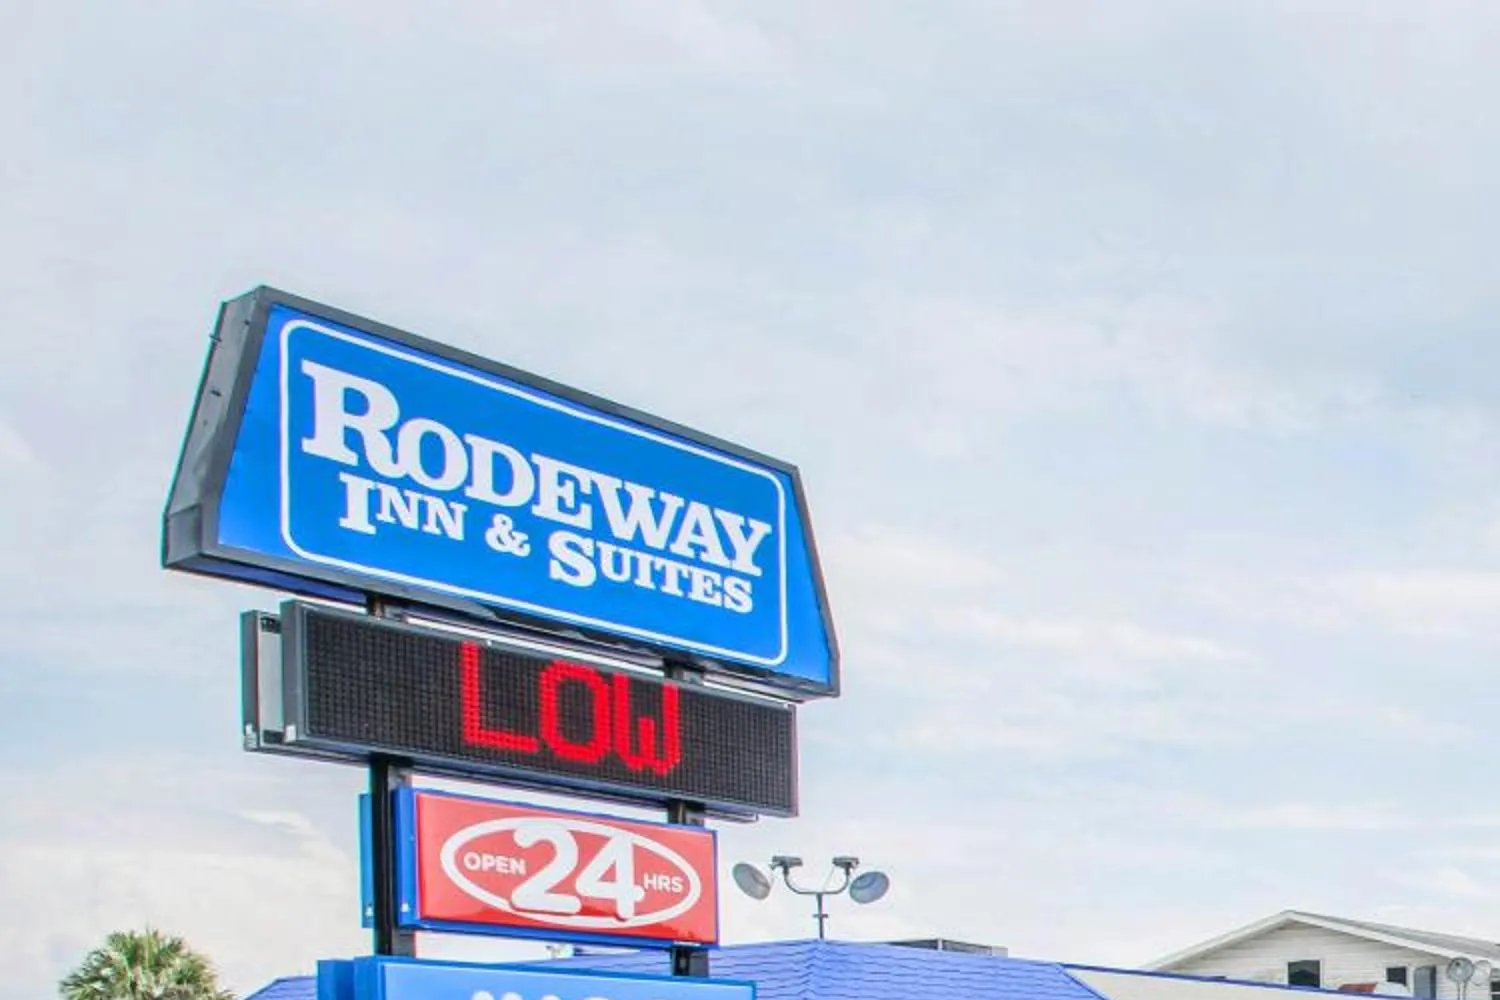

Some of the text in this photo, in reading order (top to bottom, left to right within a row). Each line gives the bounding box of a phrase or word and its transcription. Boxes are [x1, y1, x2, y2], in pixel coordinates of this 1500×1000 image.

[301, 359, 771, 576] RODEWAY
[338, 473, 753, 613] INN & SUITES
[460, 641, 682, 777] LOW
[463, 826, 684, 919] OPEN 24 HRS
